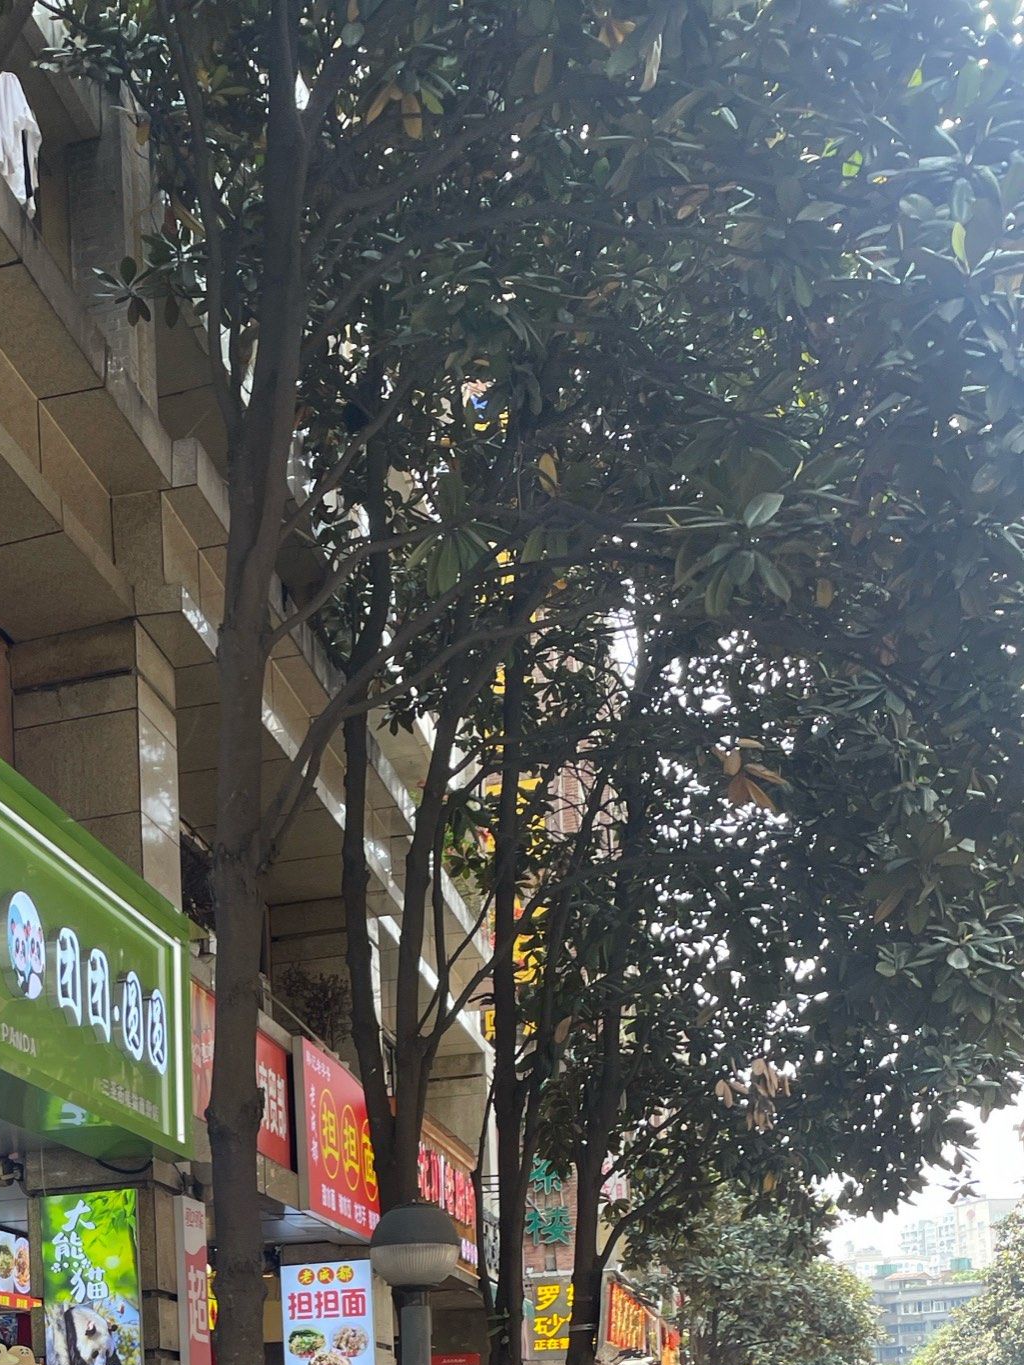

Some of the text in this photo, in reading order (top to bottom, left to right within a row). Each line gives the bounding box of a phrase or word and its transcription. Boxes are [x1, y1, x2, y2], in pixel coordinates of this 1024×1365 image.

[0, 1022, 38, 1058] PANDA
[50, 1198, 111, 1305] 大熊猫
[287, 1287, 367, 1321] 担担面
